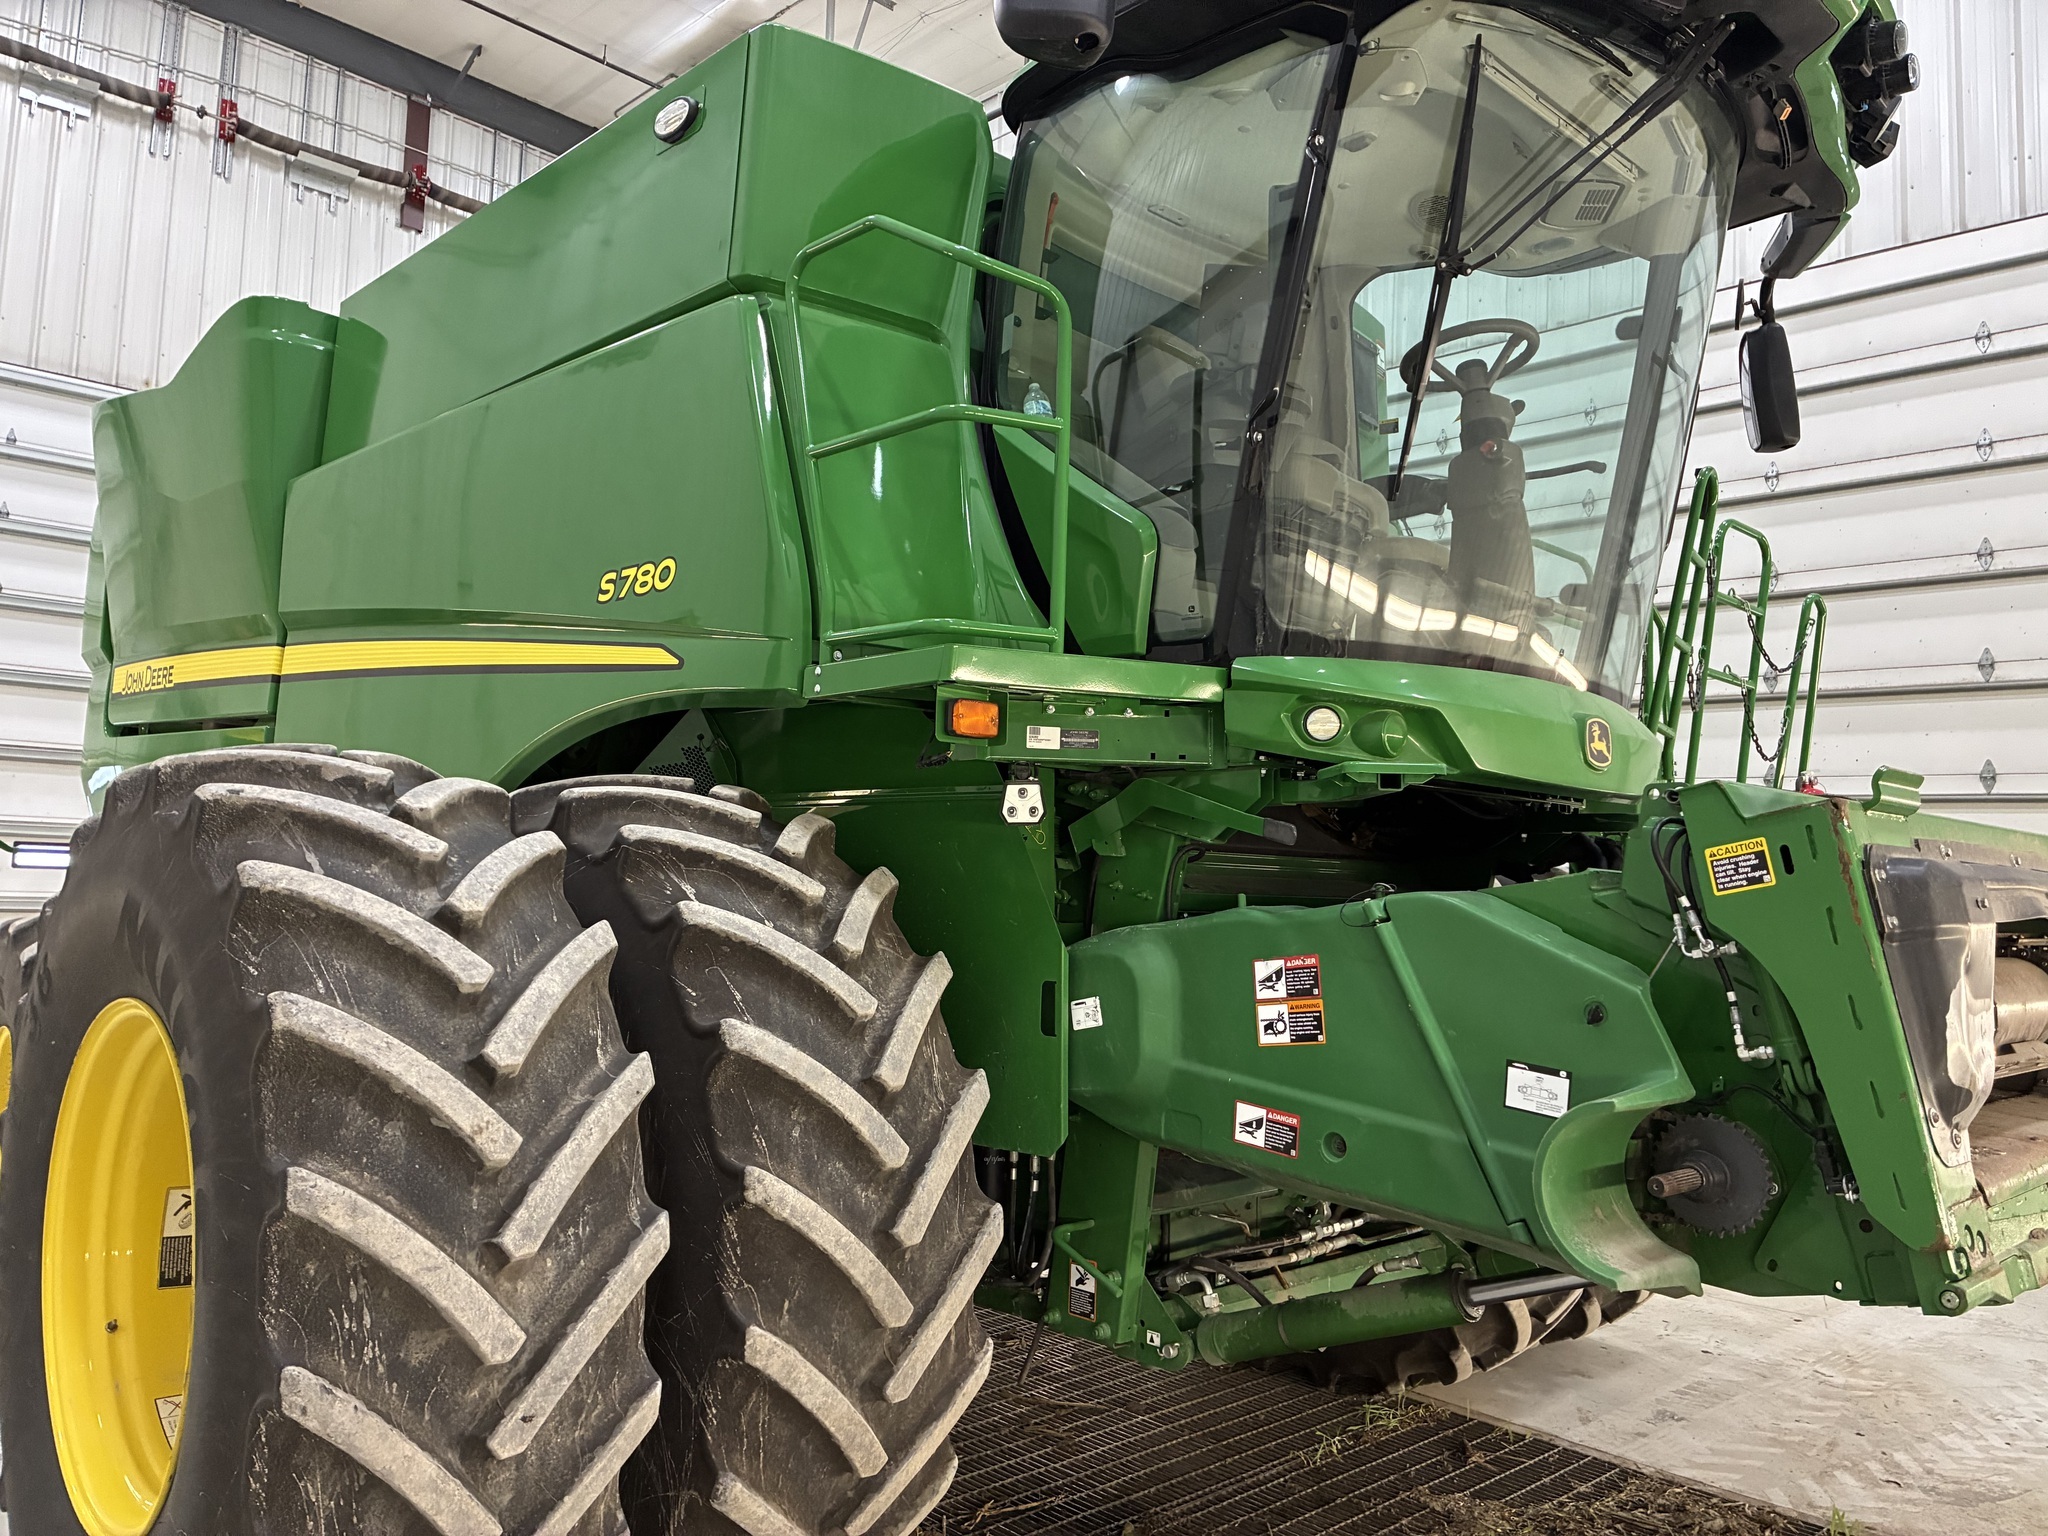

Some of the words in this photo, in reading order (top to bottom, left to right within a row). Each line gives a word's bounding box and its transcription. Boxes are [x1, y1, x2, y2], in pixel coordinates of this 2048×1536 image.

[597, 556, 677, 604] S780
[122, 670, 144, 692] JOHN
[145, 665, 174, 688] DEERE
[1716, 840, 1763, 856] CAUTION
[1713, 858, 1729, 866] Avoid
[1730, 854, 1755, 862] crushing
[1738, 859, 1759, 867] Header
[1273, 1113, 1298, 1125] DANGER
